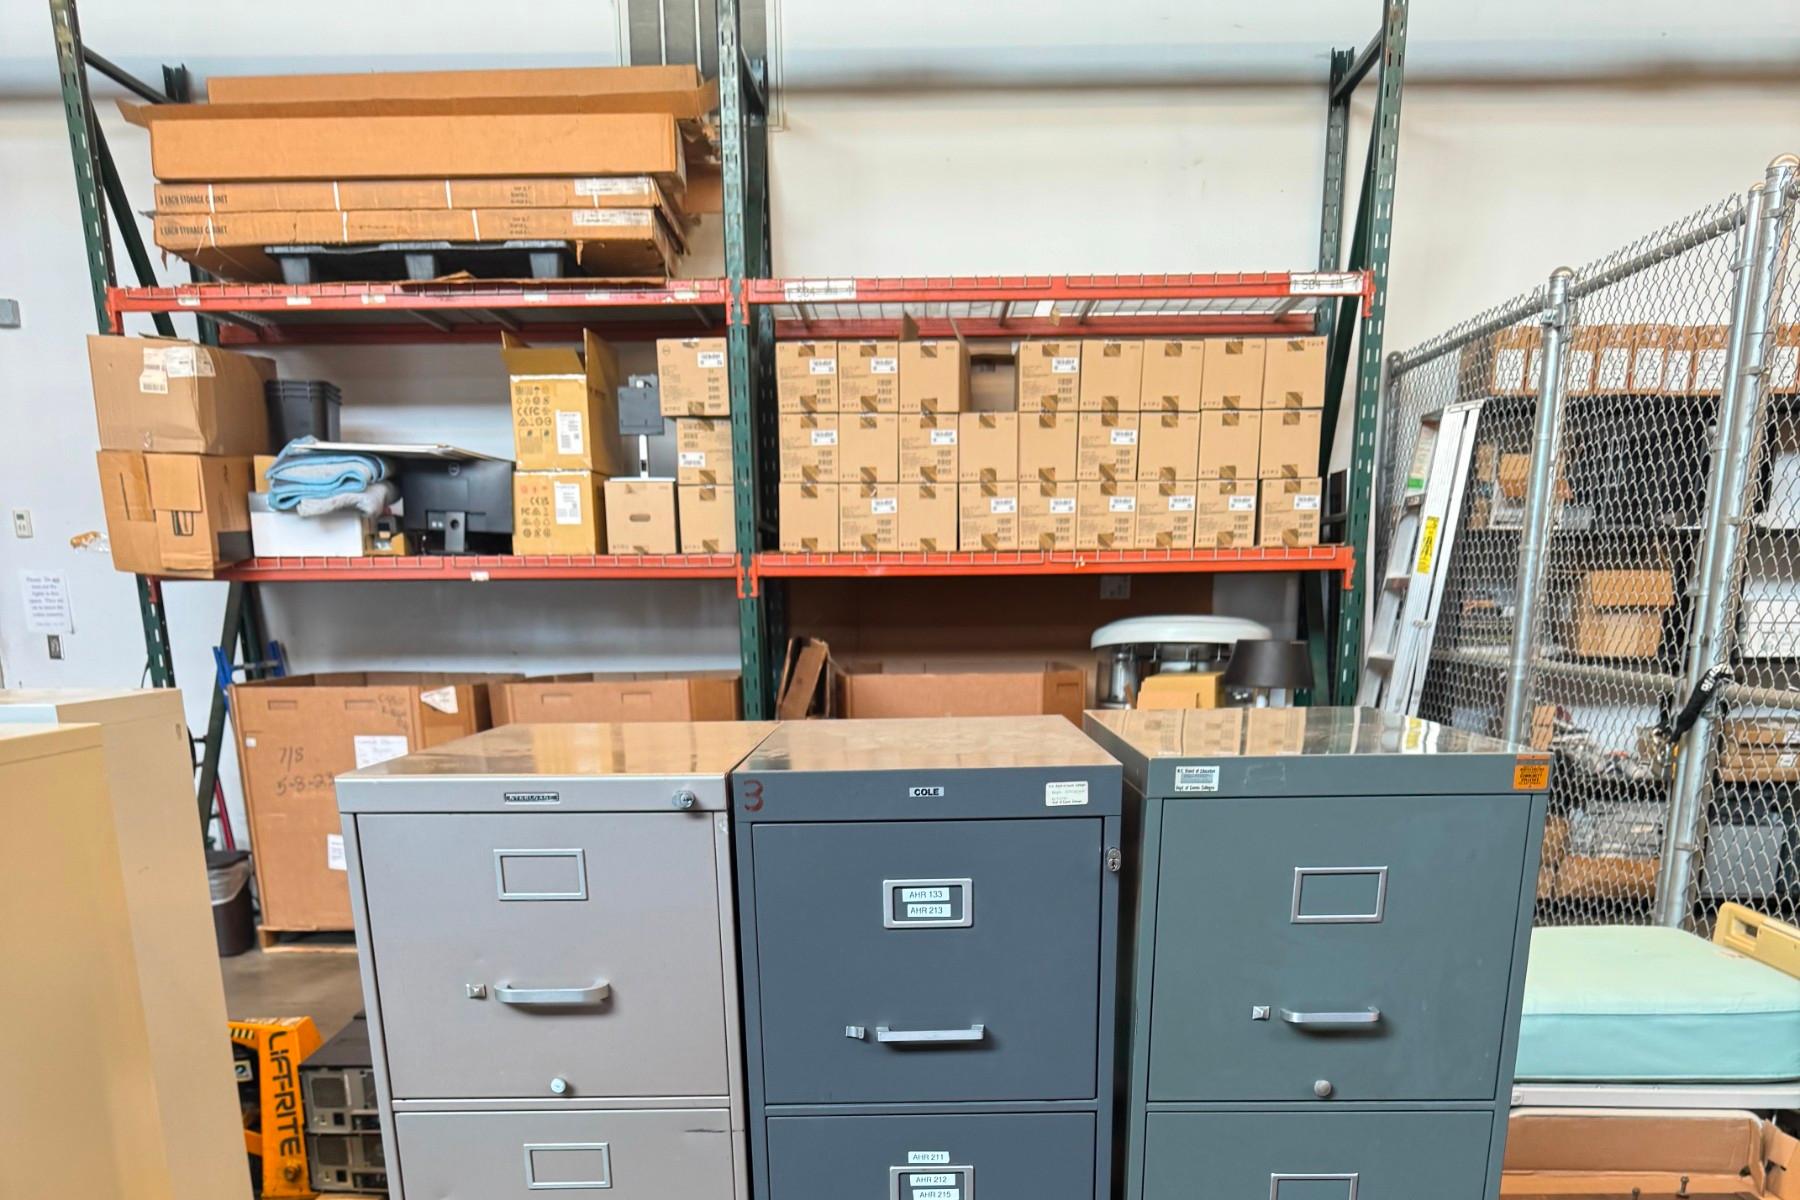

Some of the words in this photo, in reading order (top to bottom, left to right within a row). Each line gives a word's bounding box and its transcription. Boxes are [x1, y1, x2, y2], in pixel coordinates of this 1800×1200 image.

[743, 780, 764, 811] 3
[914, 788, 940, 796] COLE
[909, 891, 927, 899] AHR
[929, 890, 943, 898] 133
[929, 906, 943, 914] 213
